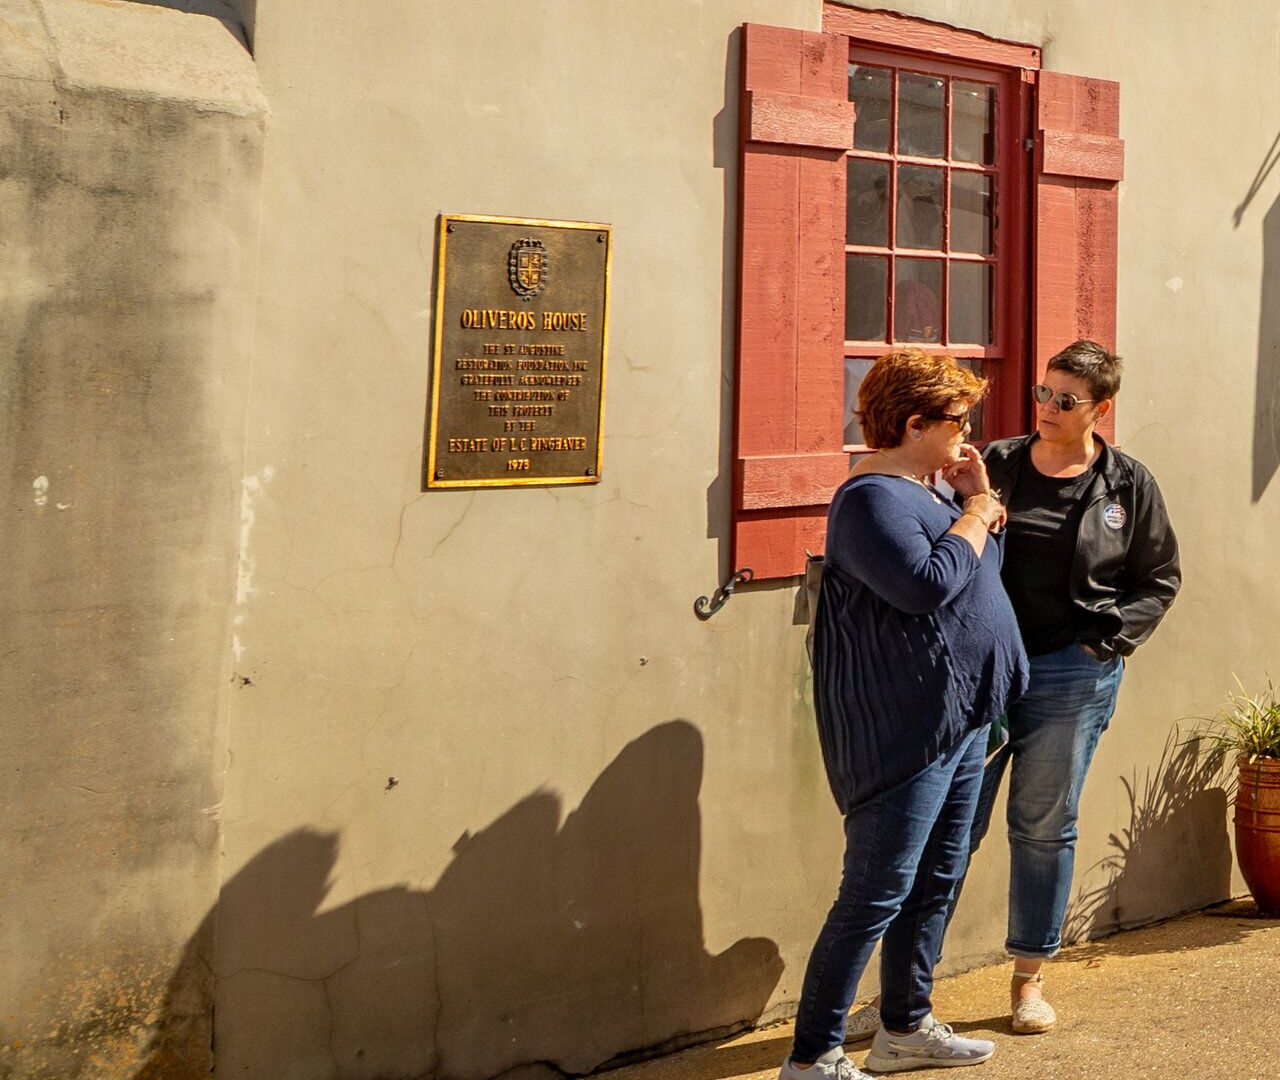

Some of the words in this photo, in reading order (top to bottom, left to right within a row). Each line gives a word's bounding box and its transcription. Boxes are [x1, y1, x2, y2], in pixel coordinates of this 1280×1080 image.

[461, 309, 536, 331] OLIVEROS
[542, 311, 588, 332] HOUSE
[448, 438, 489, 453] ESTATE
[491, 437, 507, 453] OF
